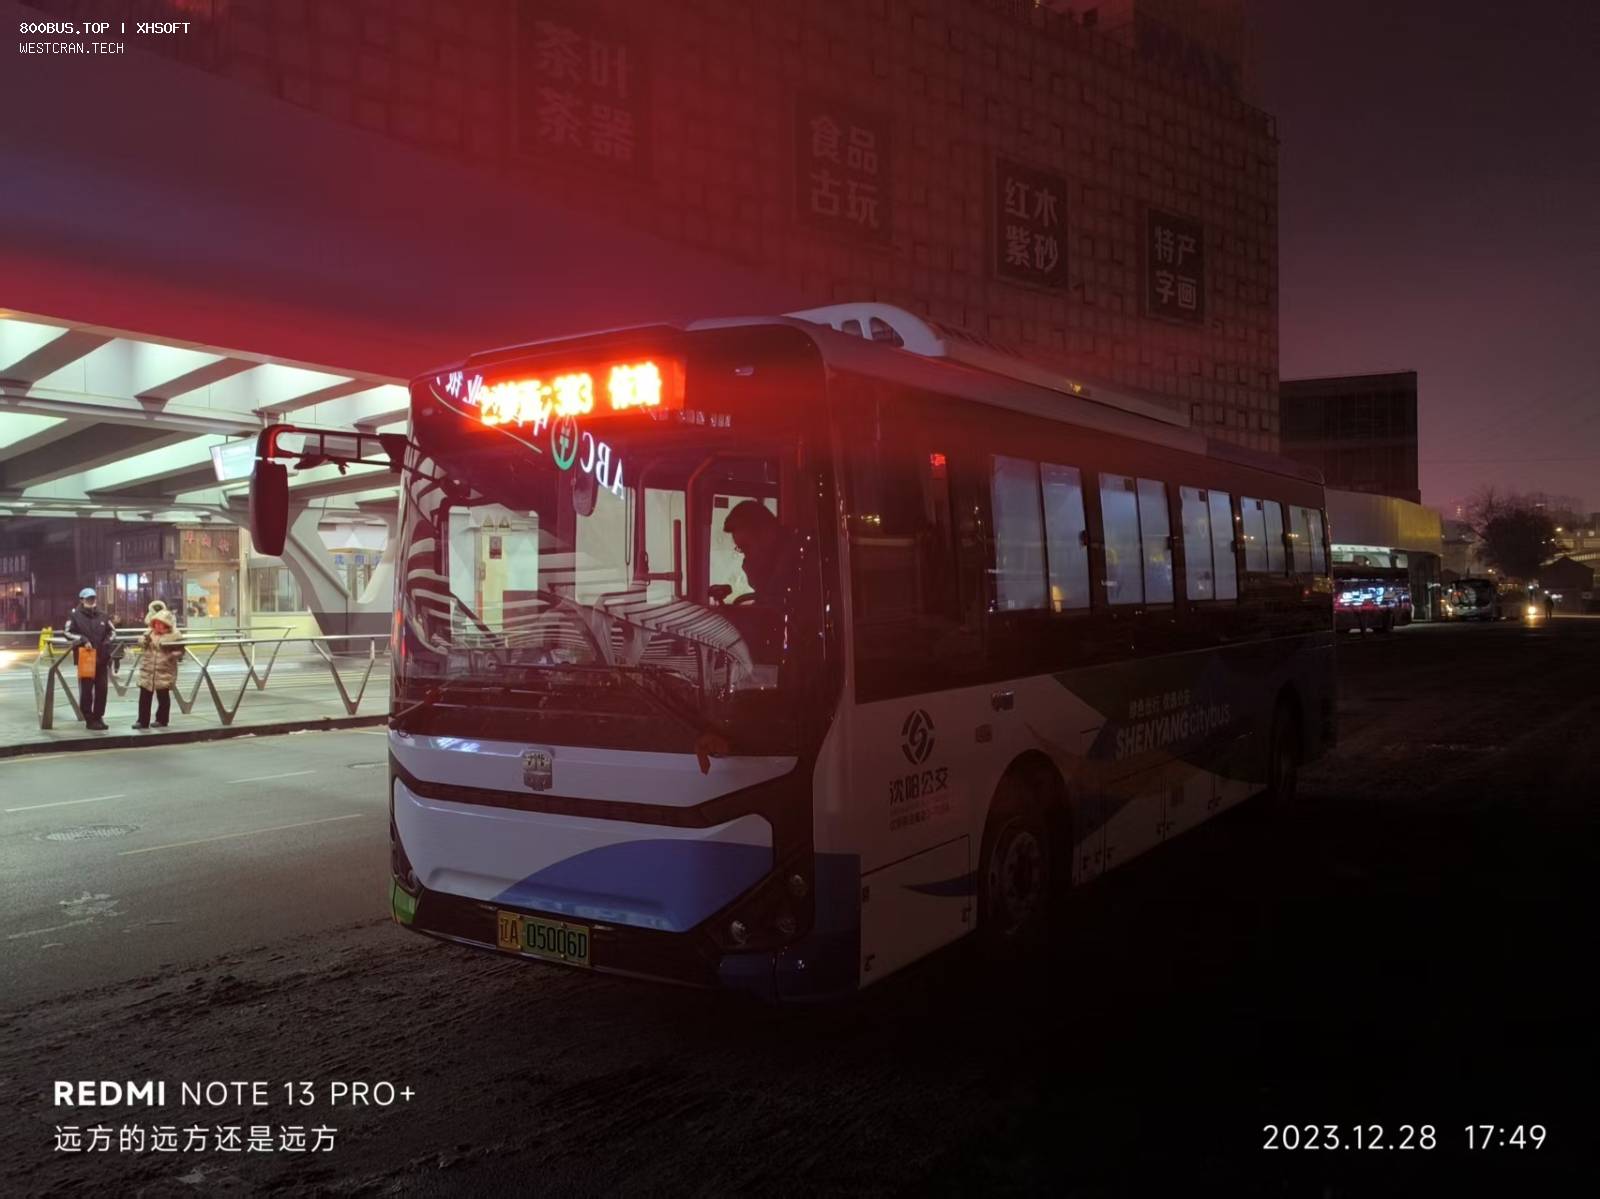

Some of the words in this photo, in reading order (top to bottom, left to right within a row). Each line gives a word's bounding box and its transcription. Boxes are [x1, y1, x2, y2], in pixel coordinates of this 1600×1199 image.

[809, 114, 877, 175] 食品
[809, 168, 879, 229] 古玩
[1004, 177, 1057, 228] 红木
[1005, 225, 1058, 273] 紫砂
[1155, 226, 1197, 265] 特产
[1155, 270, 1197, 311] 字画
[889, 767, 949, 806] 沈阳公交
